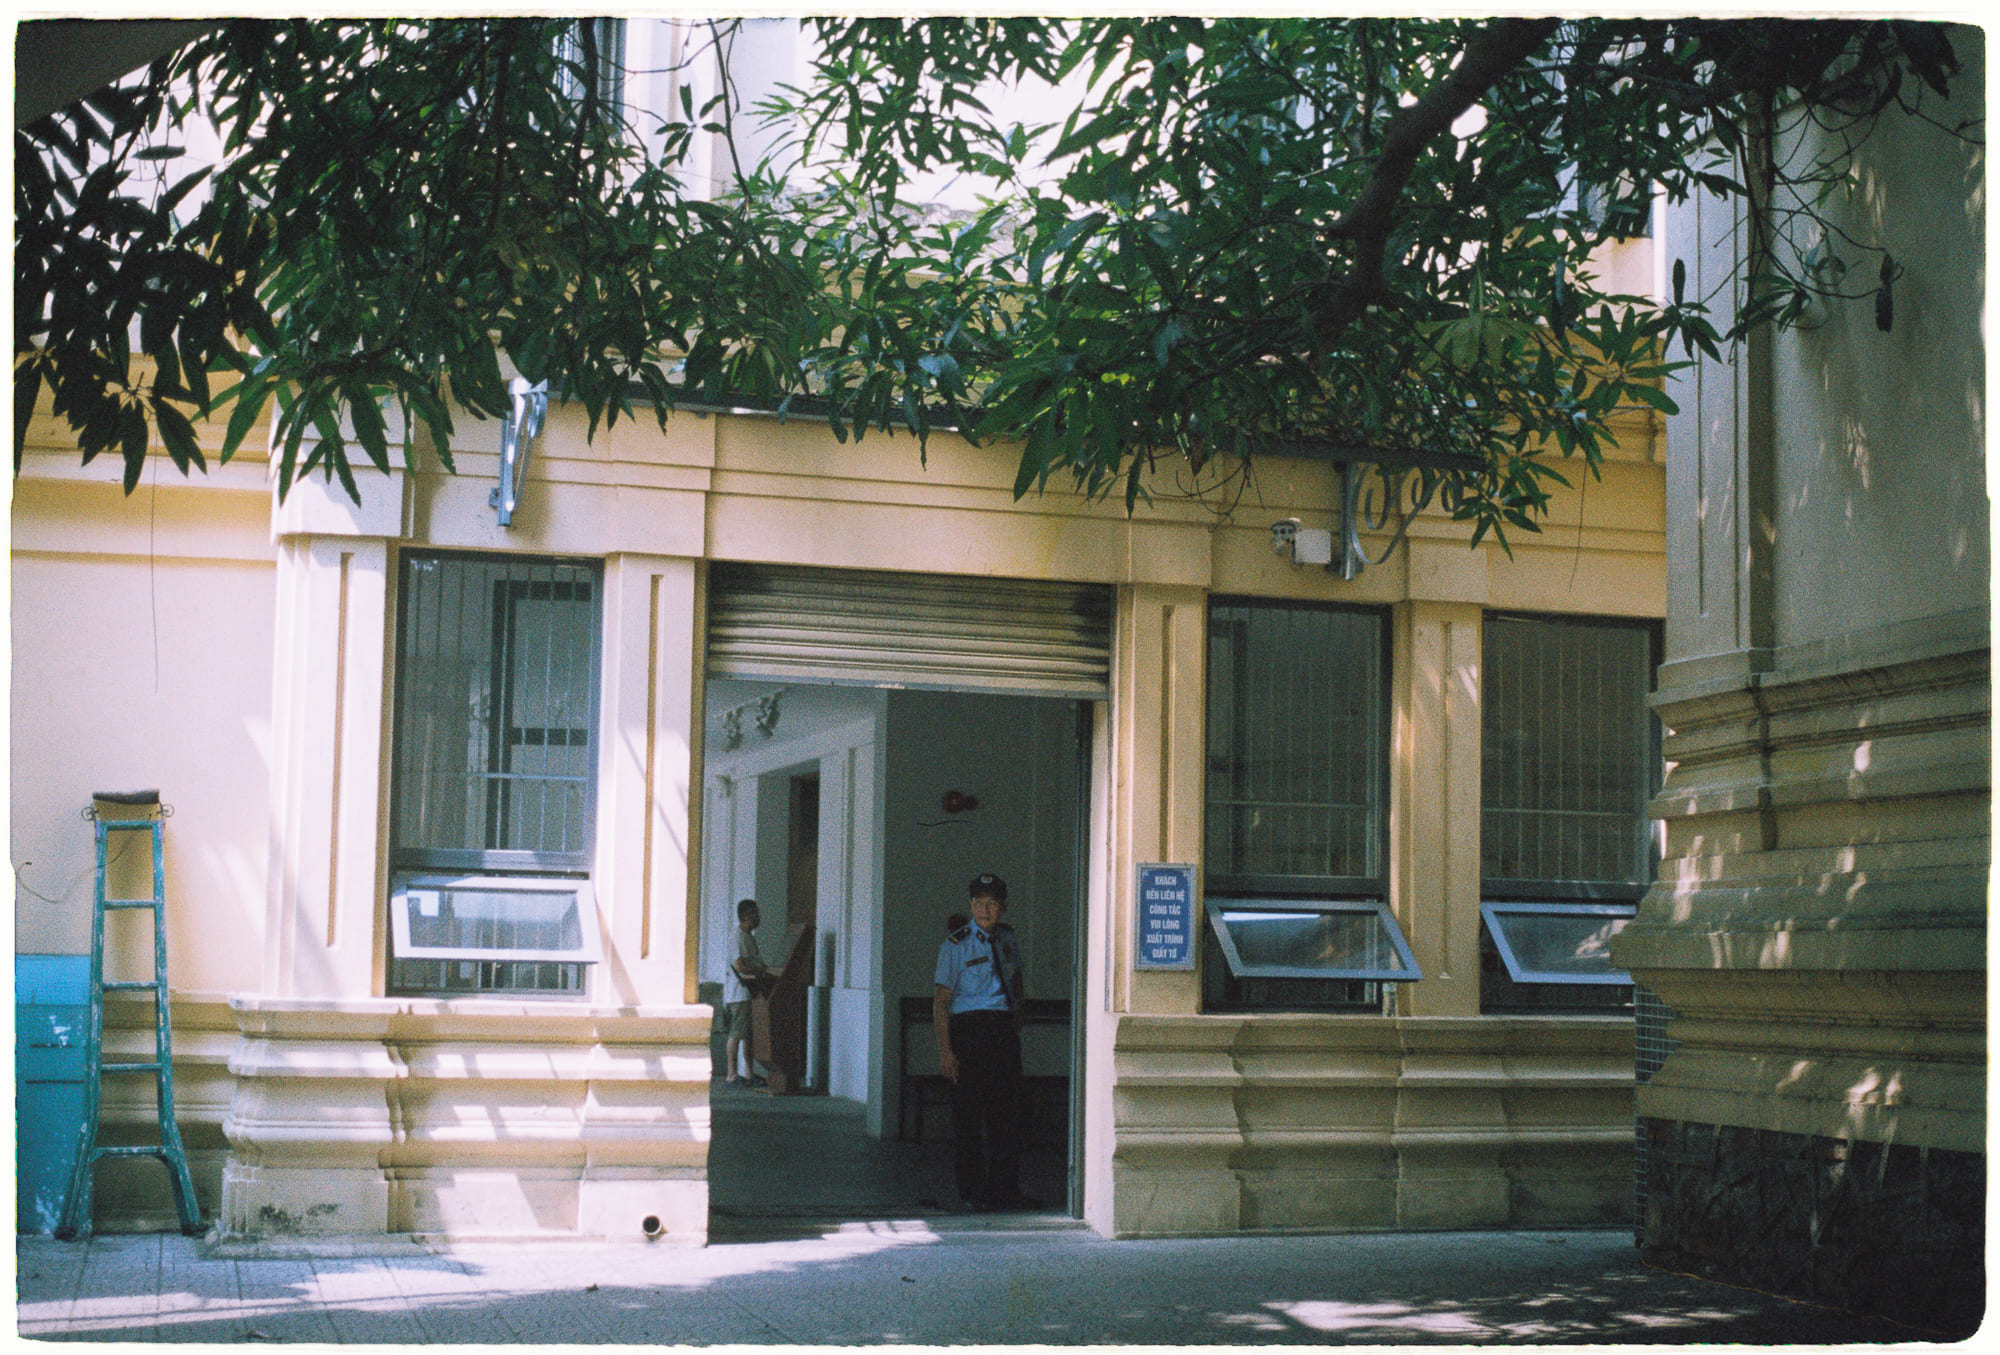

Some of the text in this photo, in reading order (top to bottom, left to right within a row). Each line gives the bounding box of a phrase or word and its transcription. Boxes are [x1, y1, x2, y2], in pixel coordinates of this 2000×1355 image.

[1155, 875, 1177, 886] KHÁCH
[1149, 903, 1181, 915] CÔNG TÁC
[1150, 919, 1161, 930] VUI
